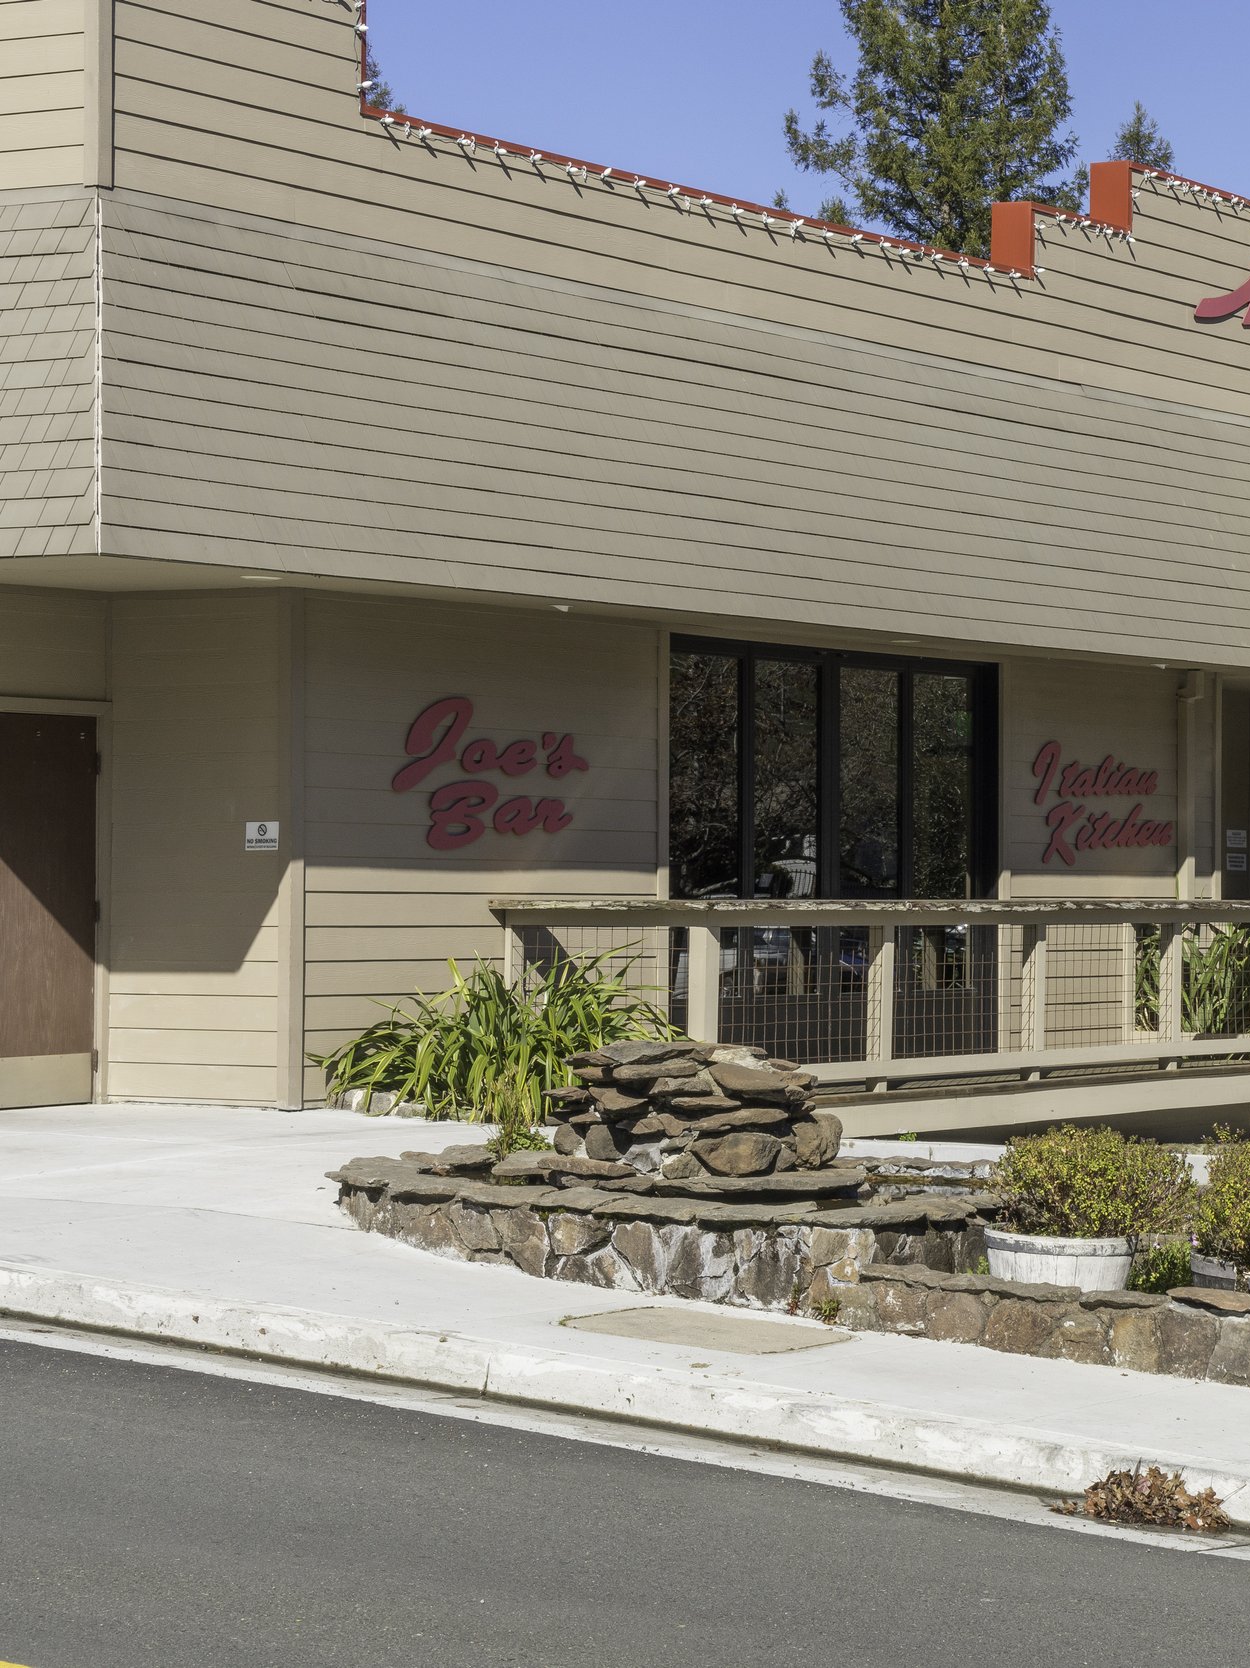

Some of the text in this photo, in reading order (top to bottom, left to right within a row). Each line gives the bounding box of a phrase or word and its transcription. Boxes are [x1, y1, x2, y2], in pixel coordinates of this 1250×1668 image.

[391, 696, 589, 791] Joe's
[1032, 739, 1158, 805] Italian
[426, 779, 574, 850] Bar
[1041, 801, 1173, 867] Kitchen
